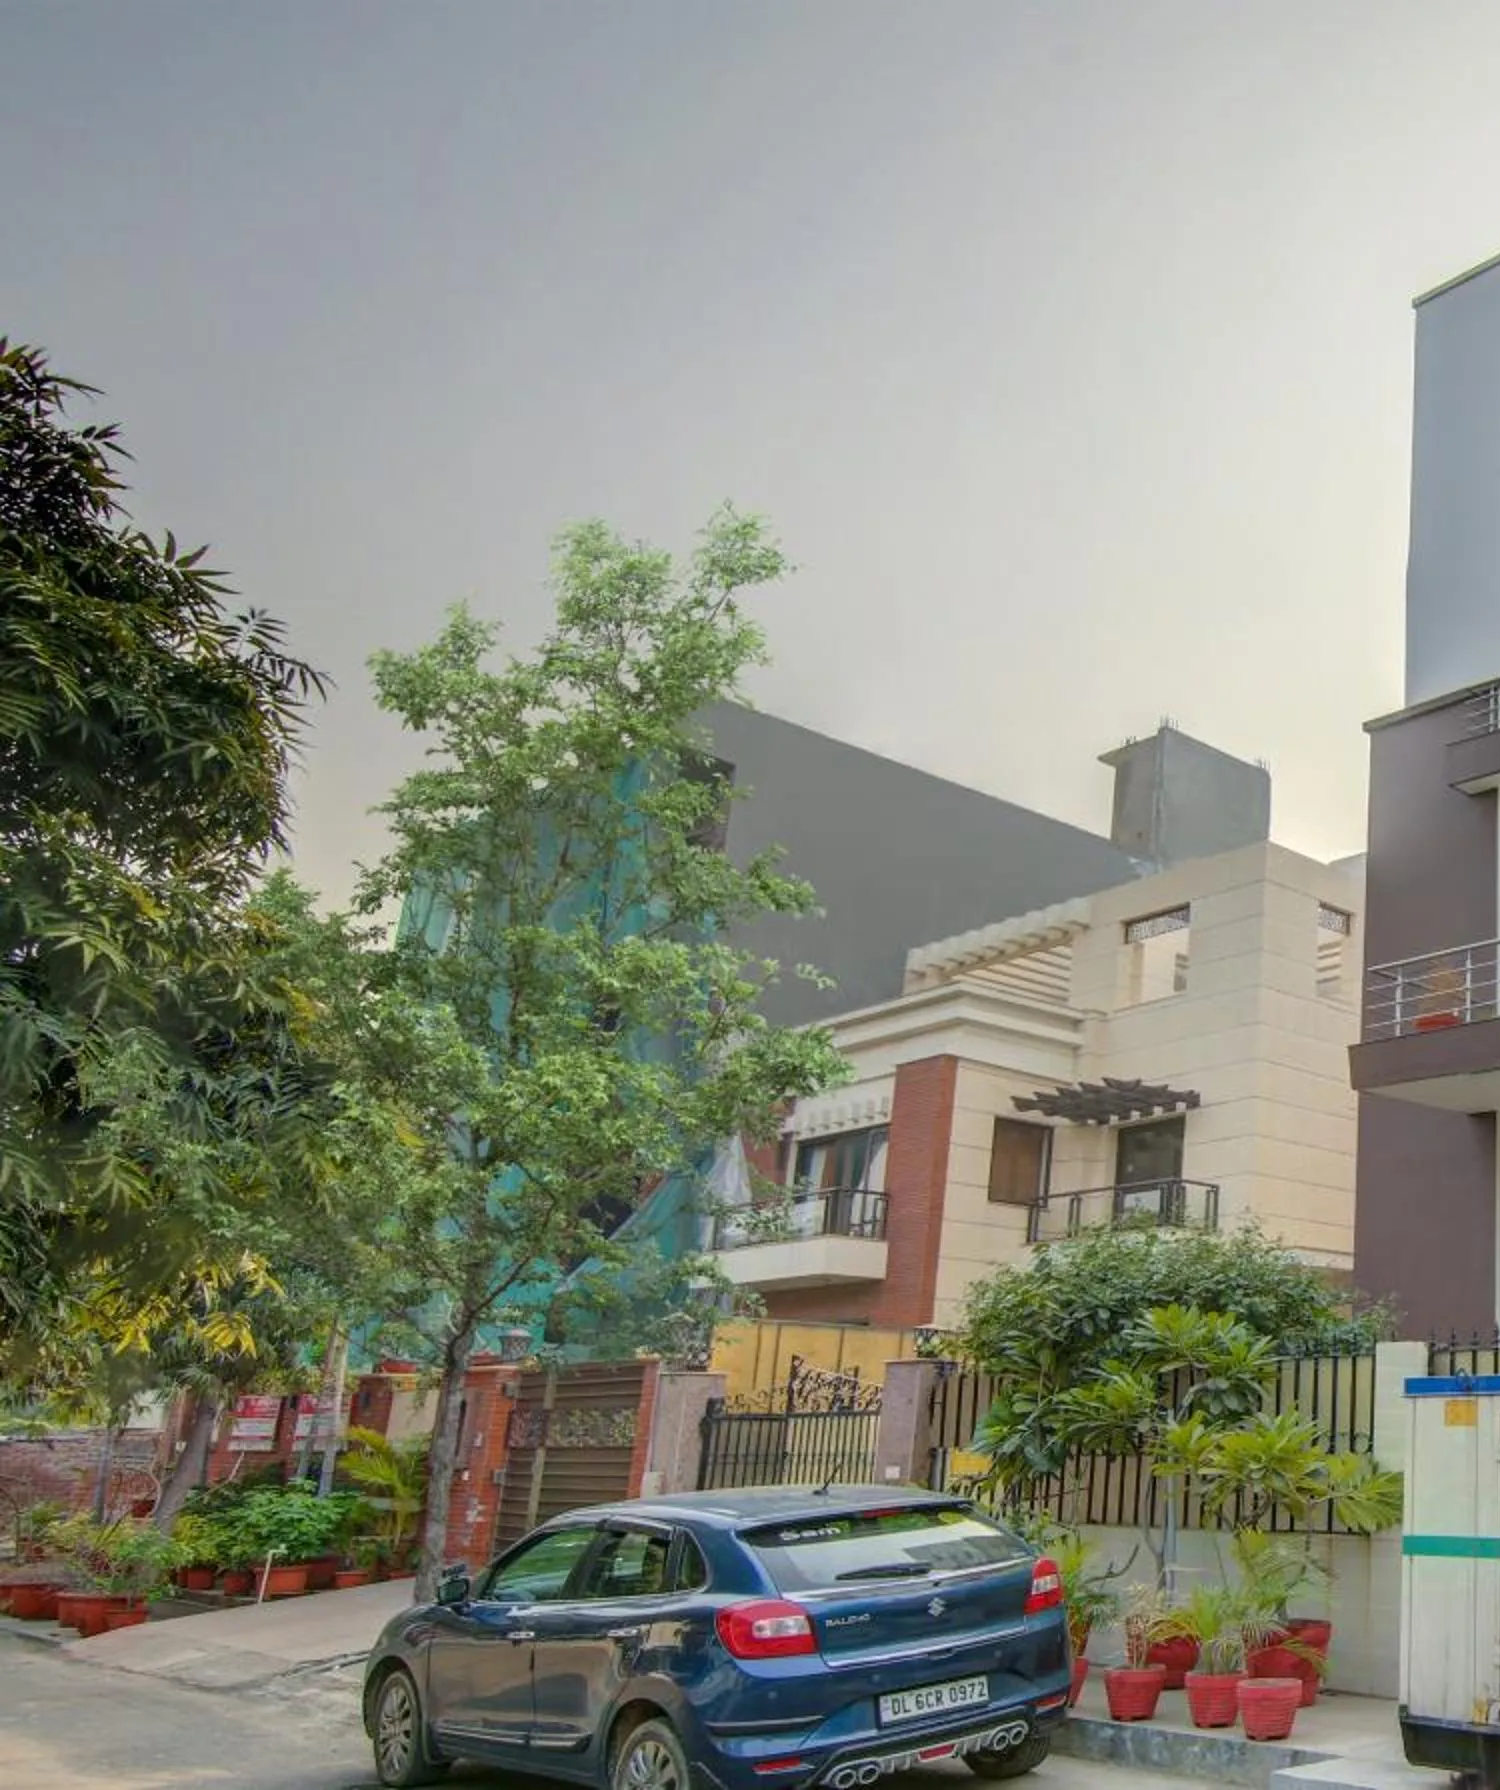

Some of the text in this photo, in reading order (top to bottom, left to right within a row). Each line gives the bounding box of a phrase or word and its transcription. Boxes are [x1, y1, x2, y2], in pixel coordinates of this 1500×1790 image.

[891, 1680, 987, 1716] DL 6CR 0972
